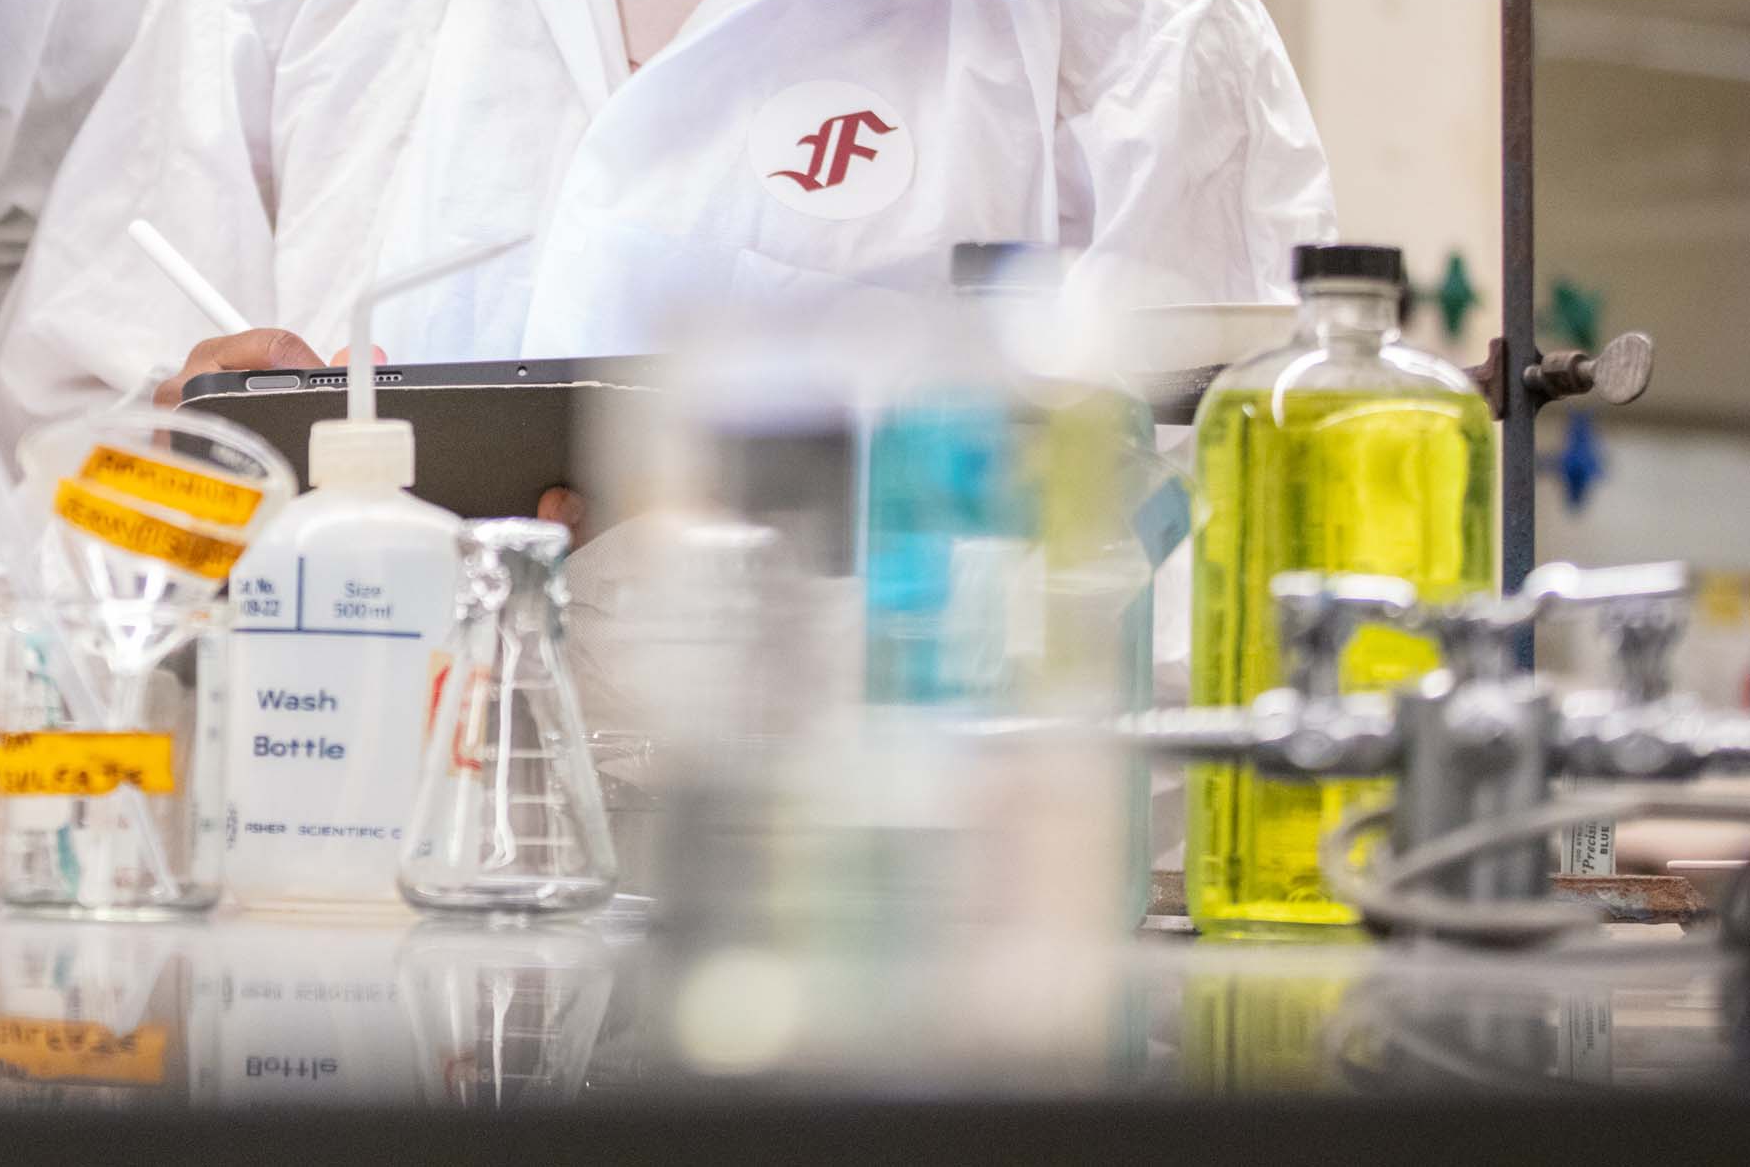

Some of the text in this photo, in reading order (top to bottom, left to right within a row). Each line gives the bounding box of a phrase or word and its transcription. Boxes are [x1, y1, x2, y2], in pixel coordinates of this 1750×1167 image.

[345, 583, 381, 598] Size
[257, 689, 337, 712] Wash
[253, 736, 346, 760] Bottle
[298, 823, 384, 839] SCIENTIFIC
[1599, 826, 1610, 855] BLUE
